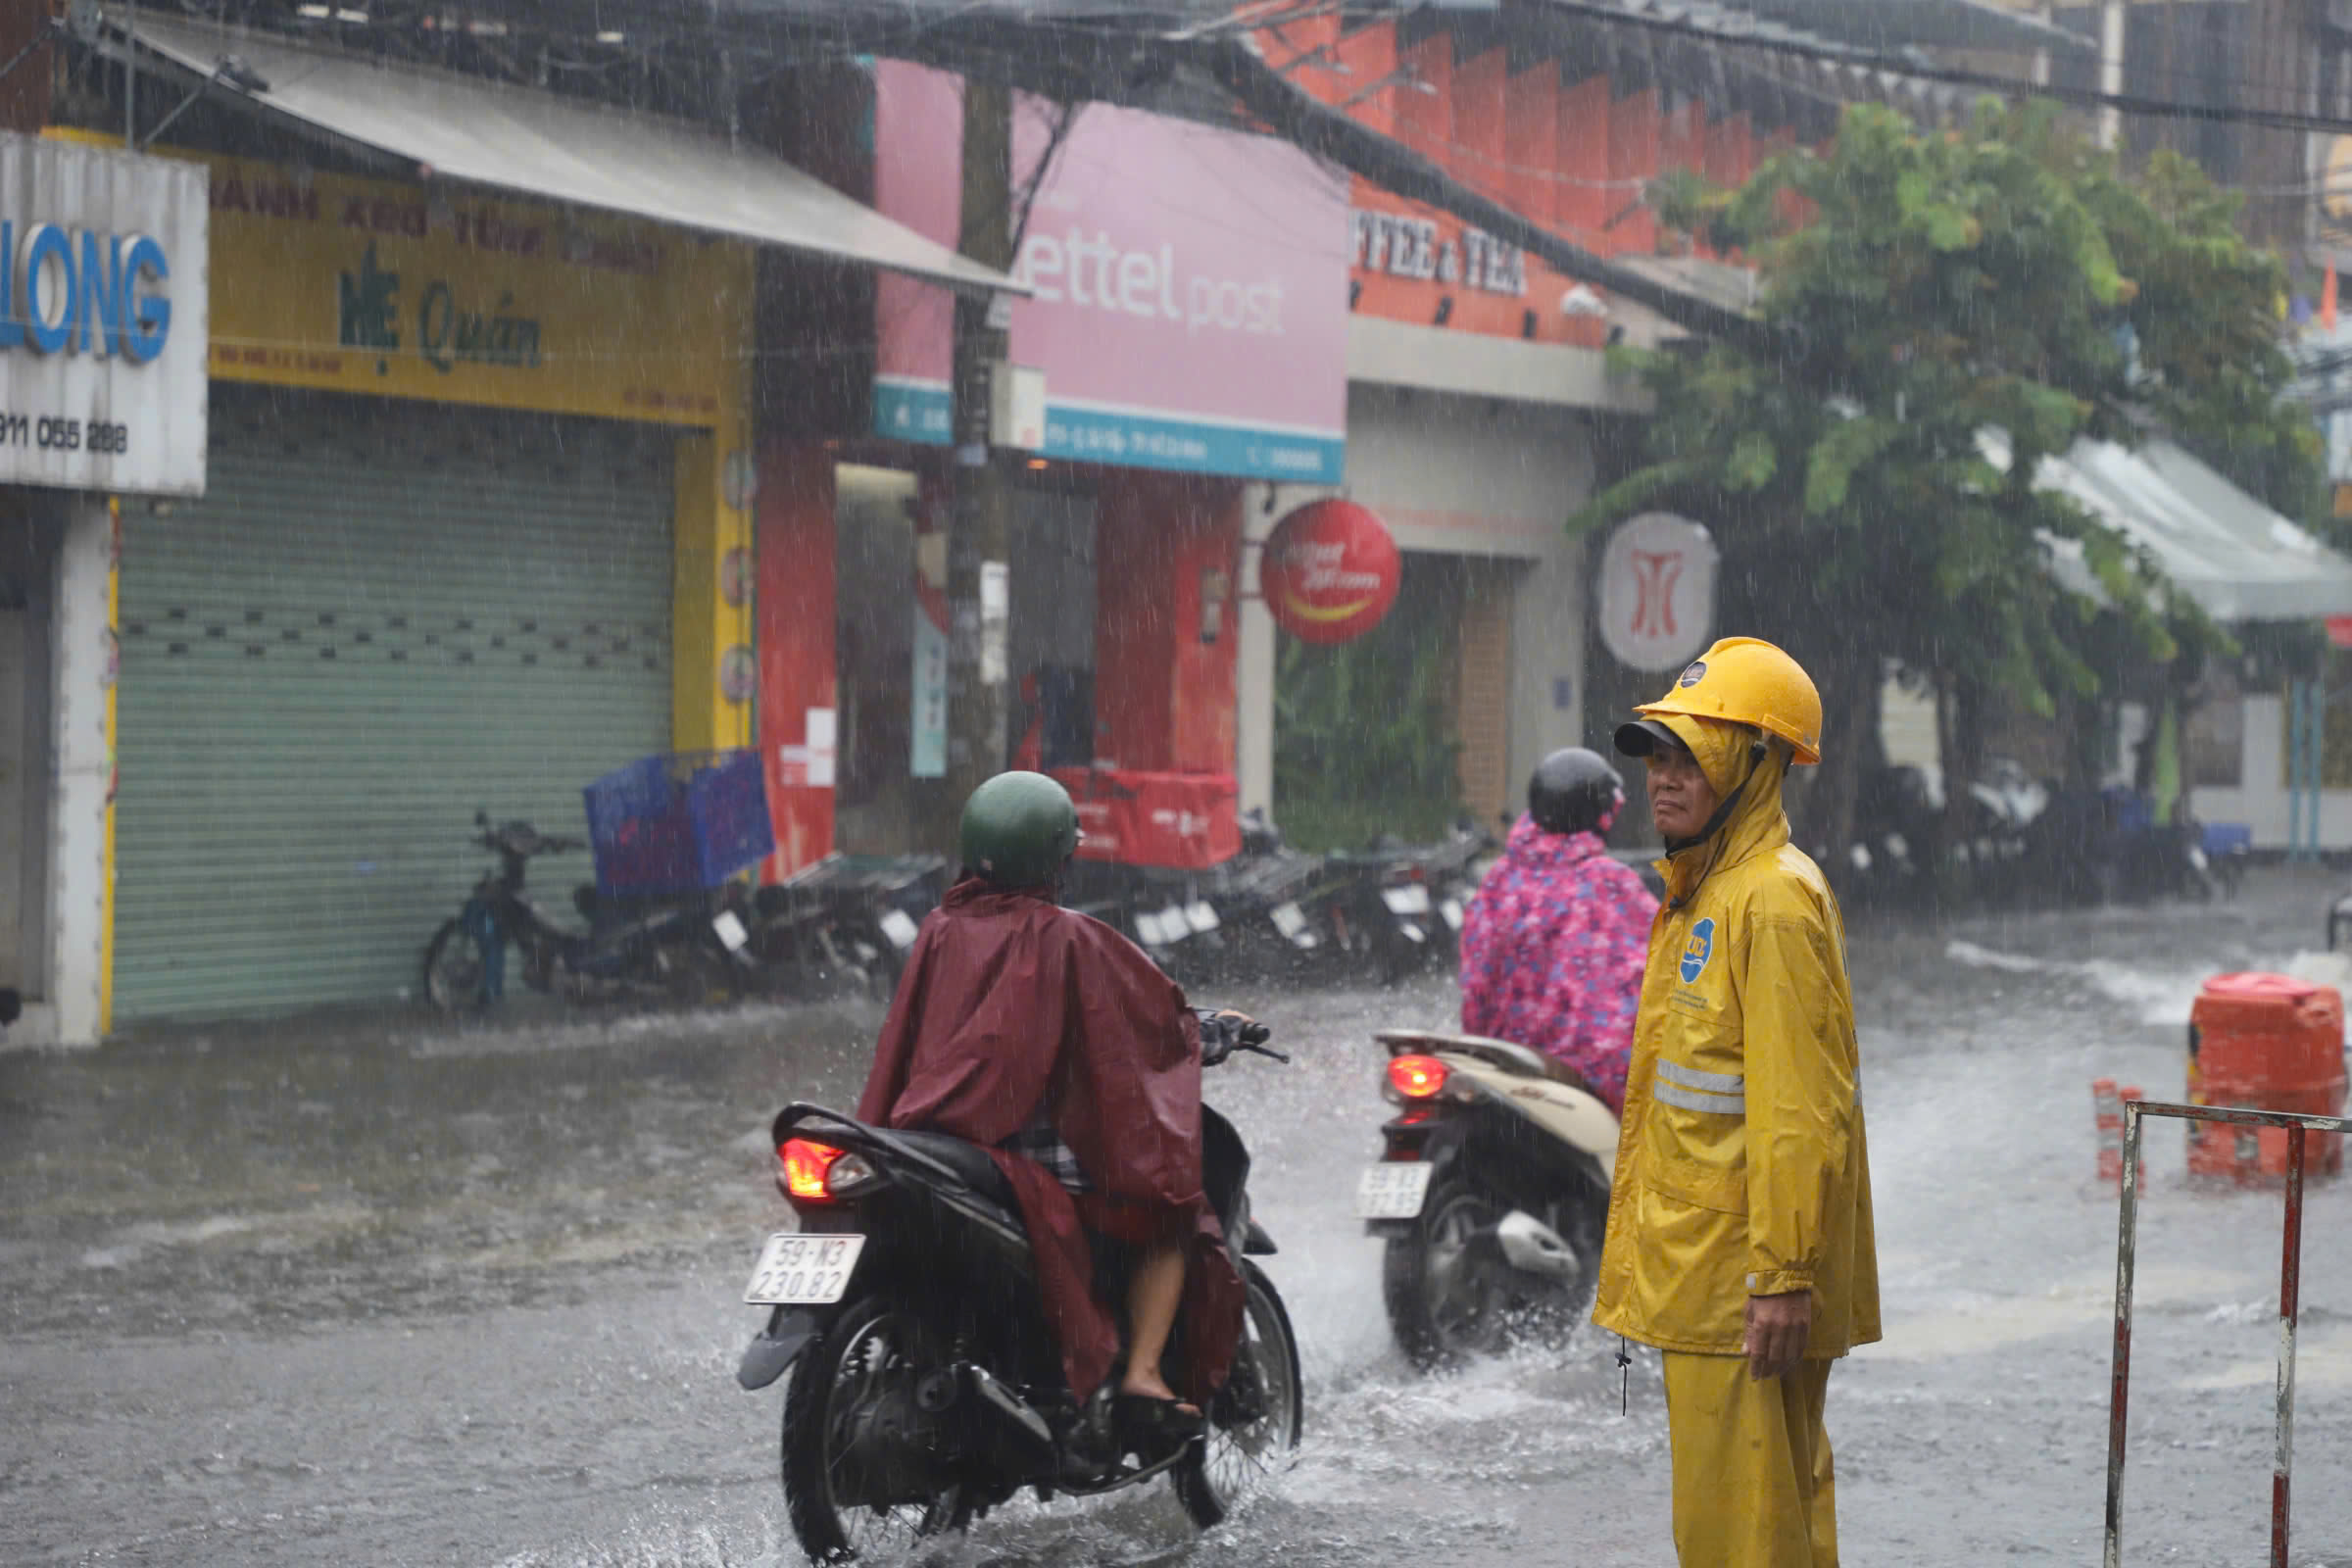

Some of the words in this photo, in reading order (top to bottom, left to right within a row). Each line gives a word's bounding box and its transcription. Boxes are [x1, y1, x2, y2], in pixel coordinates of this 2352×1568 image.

[0, 220, 172, 366] LONG
[1019, 225, 1183, 321] ettel
[1185, 272, 1287, 336] post
[1348, 208, 1439, 282] FFEE
